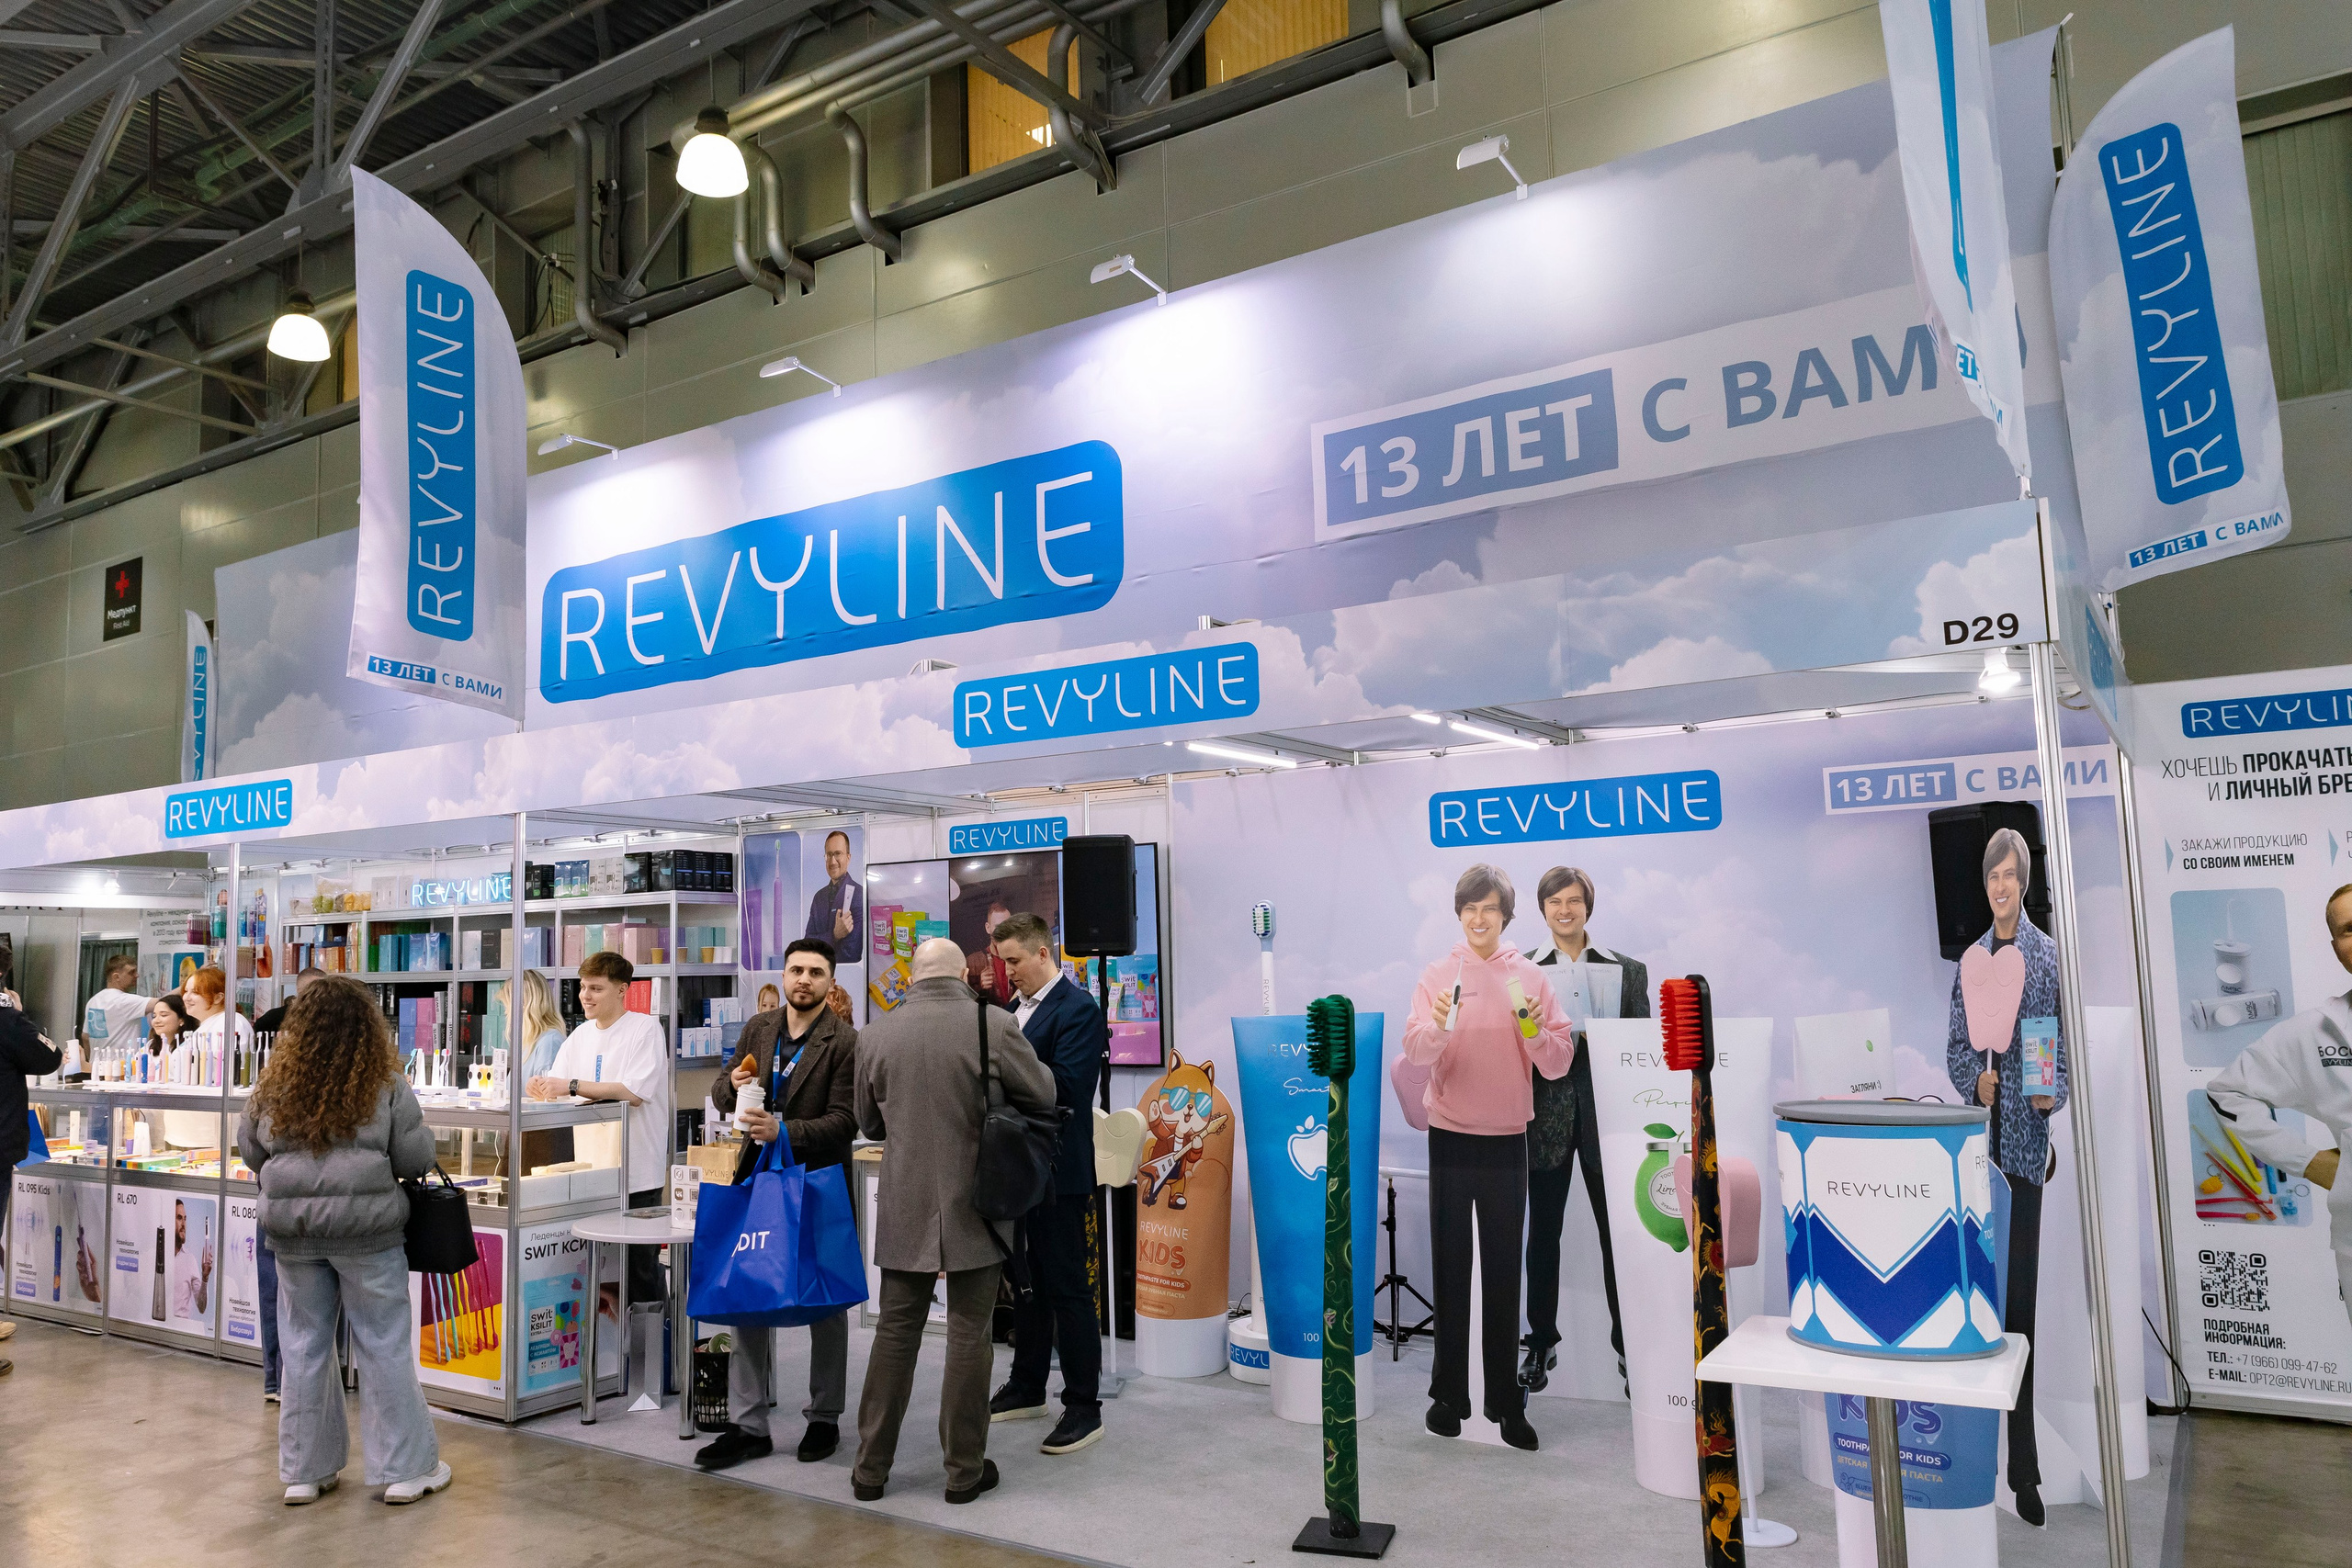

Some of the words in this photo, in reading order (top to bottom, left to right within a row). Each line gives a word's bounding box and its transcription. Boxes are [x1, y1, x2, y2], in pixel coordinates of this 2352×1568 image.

[2112, 136, 2228, 488] REVYLINE
[1957, 345, 1974, 377] ЕТ
[1339, 436, 1419, 505] 13
[1443, 394, 1593, 488] ЛЕТ
[1641, 377, 1690, 443] С
[1721, 304, 2027, 429] ВАМ
[416, 282, 463, 626] REVYLINE
[2133, 547, 2156, 564] 13
[2162, 534, 2199, 557] ЛЕТ
[2215, 526, 2228, 540] С
[560, 470, 1094, 680] REVYLINE
[1943, 613, 2019, 645] D29
[372, 659, 392, 674] 13
[397, 663, 432, 682] ЛЕТ
[442, 672, 450, 685] С
[455, 675, 503, 700] ВАМИ
[965, 656, 1247, 738] REVYLINE
[194, 650, 207, 781] VLINE
[2190, 694, 2352, 732] REVYLI
[2161, 755, 2238, 779] ХОЧЕШЬ
[1836, 777, 1873, 802] 13
[1883, 770, 1947, 800] ЛЕТ
[1965, 769, 1985, 793] С
[2208, 782, 2221, 802] И
[2225, 772, 2312, 801] ЛИЧНЫЙ
[2318, 773, 2352, 795] БРЕ
[169, 786, 288, 832] REVYLINE
[1440, 780, 1710, 839] REVYLINE
[954, 821, 1063, 850] REVYLINE
[2181, 837, 2232, 852] ЗАКАЖИ
[2233, 832, 2308, 850] ПРОДУКЦИЮ
[2183, 857, 2198, 870] СО
[2200, 855, 2241, 869] СВОИМ
[2244, 852, 2295, 867] ИМЕНЕМ
[412, 875, 513, 907] REVYLINE
[1621, 1052, 1729, 1067] REVE
[2318, 1045, 2352, 1057] БОС
[703, 1168, 729, 1179] VYLINE
[18, 1182, 26, 1193] RL
[27, 1183, 38, 1194] 095
[38, 1184, 51, 1195] Kids
[117, 1193, 125, 1204] RL
[126, 1194, 138, 1205] 670
[1827, 1180, 1930, 1199] REVYLINE
[232, 1205, 240, 1218] RL
[530, 1229, 565, 1242] Леденцы
[1140, 1221, 1189, 1240] REVYLINE
[525, 1243, 559, 1261] SWIT
[562, 1236, 611, 1254] КСИ
[731, 1231, 770, 1258] DIT
[1139, 1237, 1186, 1269] KIDS
[1159, 1278, 1170, 1286] FOR
[1170, 1280, 1185, 1289] KIDS
[530, 1320, 553, 1331] KSILIT
[1303, 1332, 1320, 1342] 100
[2203, 1318, 2270, 1336] ПОДРОБНАЯ
[2205, 1331, 2287, 1350] ИНФОРМАЦИЯ:
[1230, 1345, 1269, 1367] REVYL
[2207, 1350, 2233, 1364] ТЕЛ.:
[2236, 1354, 2248, 1365] +7
[2251, 1355, 2278, 1370] (966)
[2281, 1358, 2337, 1375] 099-47-62
[2209, 1368, 2247, 1383] E-MAIL:
[2249, 1371, 2352, 1393] OPT2@REVYLINE.RU
[1667, 1394, 1688, 1407] 100
[1838, 1393, 1942, 1435] KS
[1838, 1438, 1871, 1452] TOOTHPA
[1899, 1450, 1913, 1461] OR
[1916, 1453, 1941, 1466] KIDS
[1909, 1472, 1943, 1483] ПАСТА
[1903, 1494, 1924, 1503] OTHIE
